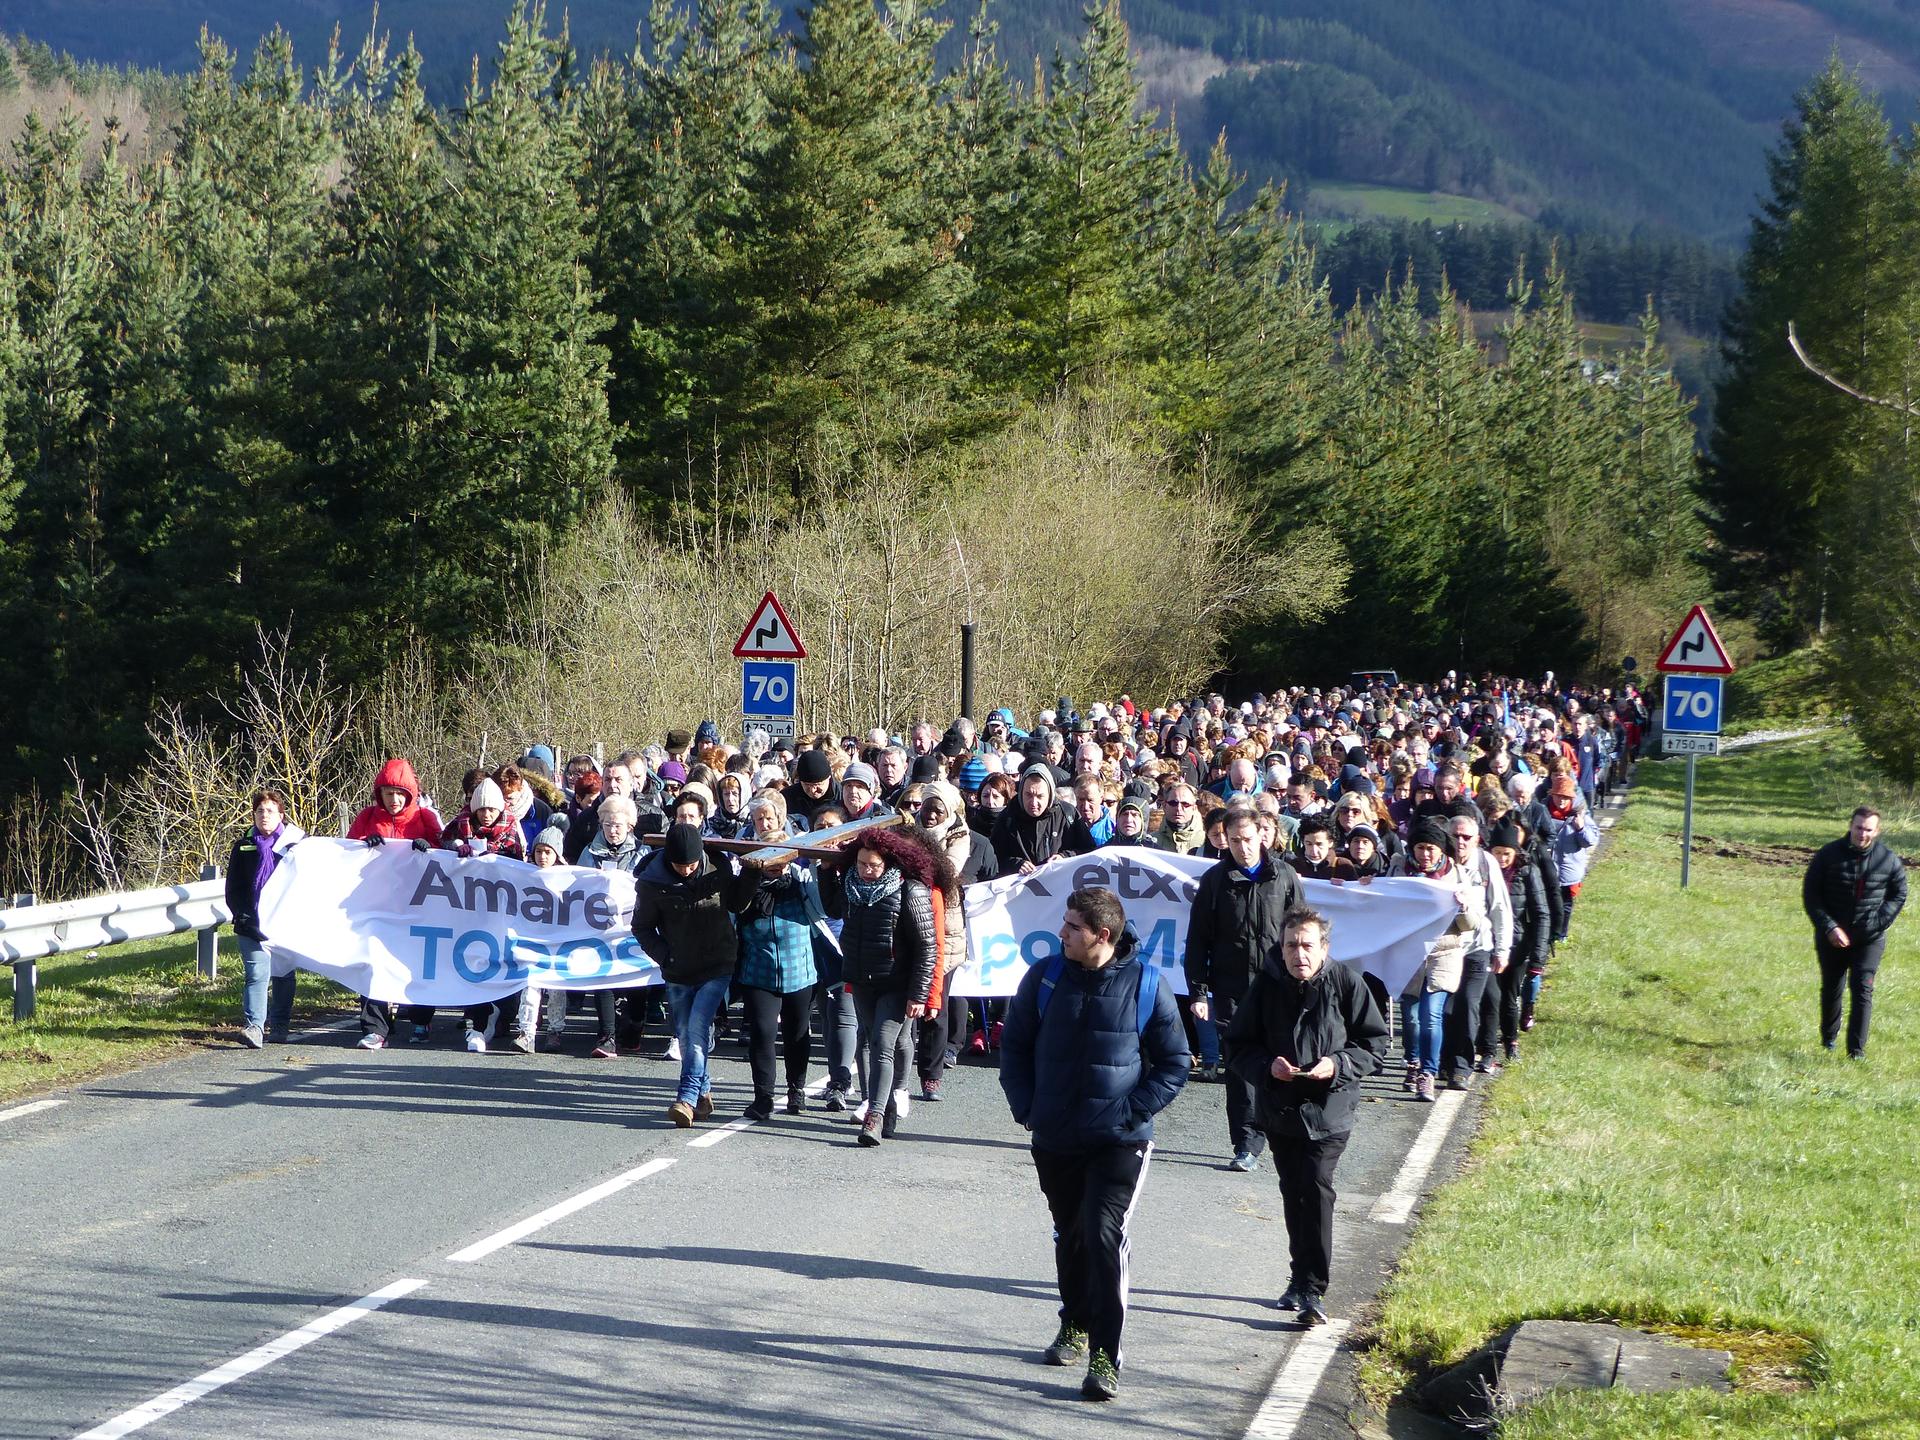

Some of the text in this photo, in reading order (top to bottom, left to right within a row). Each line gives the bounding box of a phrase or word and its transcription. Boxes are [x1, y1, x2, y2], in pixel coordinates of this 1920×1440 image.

[749, 675, 789, 703] 70
[1671, 690, 1714, 718] 70
[1675, 739, 1696, 750] 750
[409, 859, 634, 931] Amare
[980, 930, 1064, 986] po
